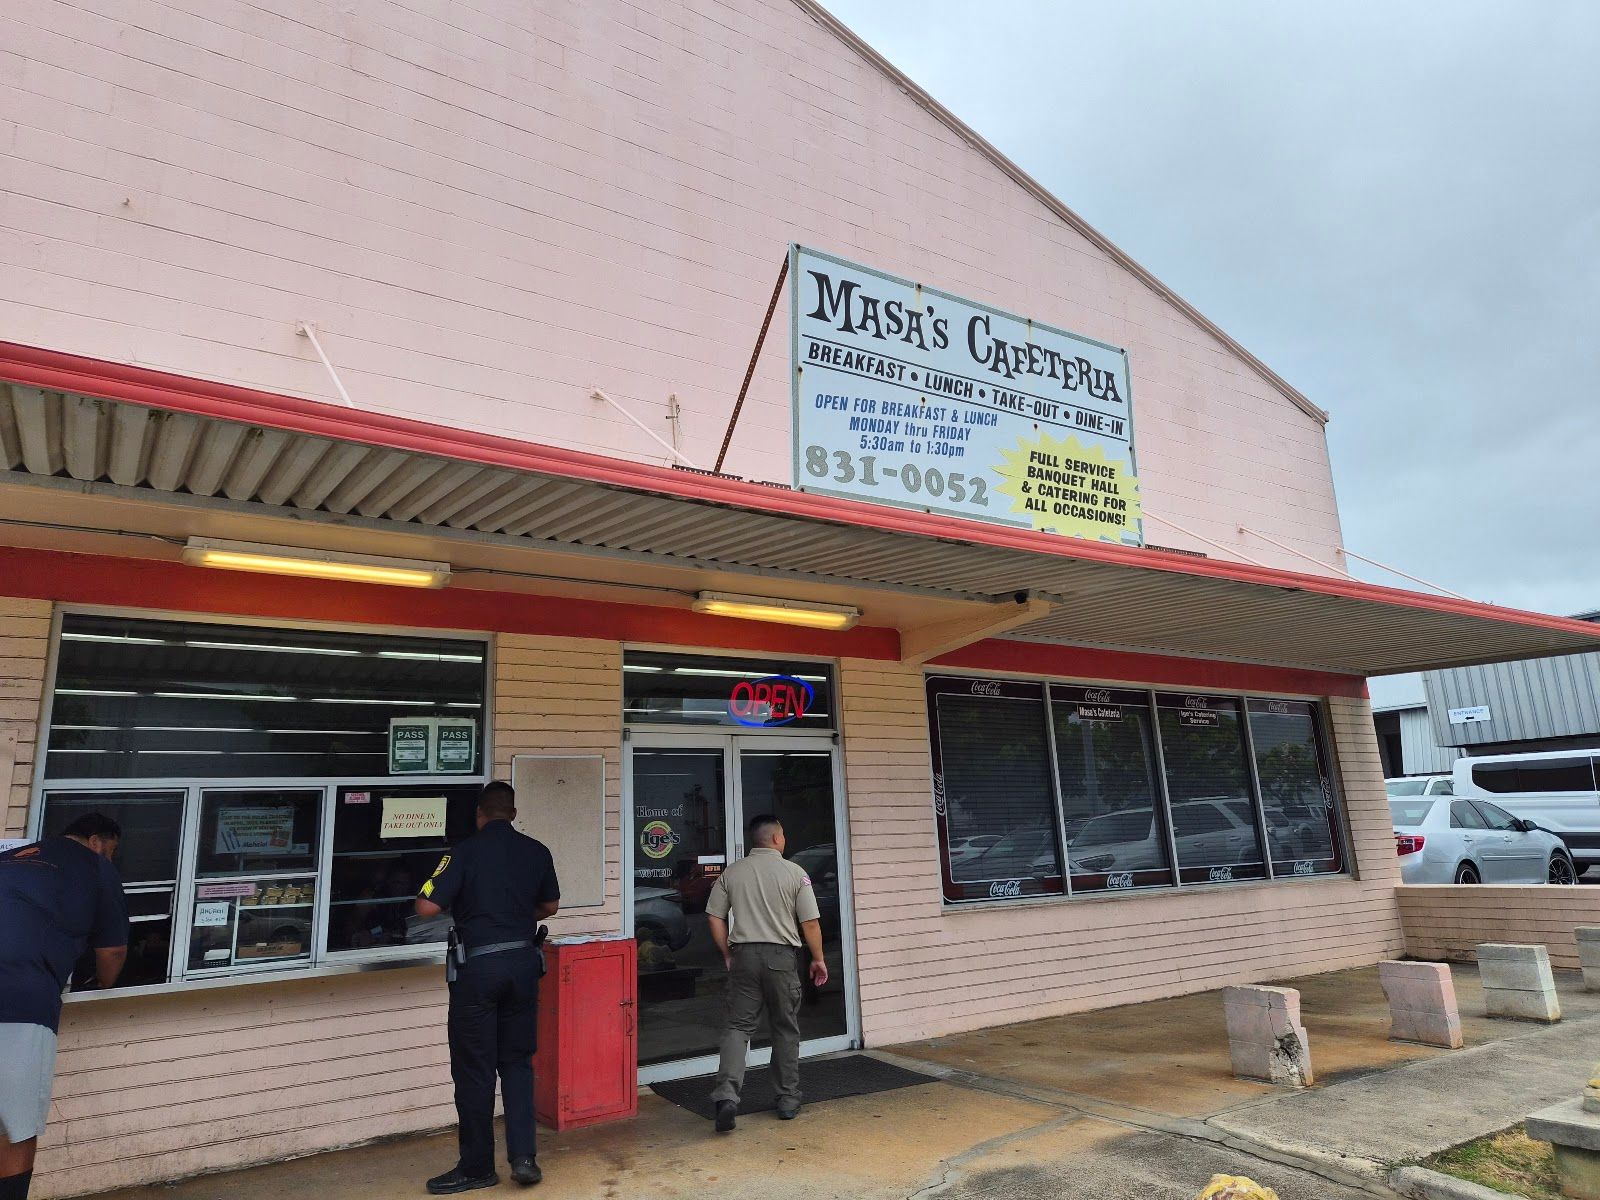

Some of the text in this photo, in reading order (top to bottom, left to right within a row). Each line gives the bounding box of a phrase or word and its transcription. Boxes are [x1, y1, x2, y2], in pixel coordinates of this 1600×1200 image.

[807, 270, 1123, 403] MASA'S CAFETERIA
[808, 342, 1124, 436] BREAKFAST LUNCH TAKE-OUT DINE-IN
[815, 393, 998, 426] OPEN FOR BREAKFAST & LUNCH
[849, 417, 970, 441] MONDAY thru FRIDAY
[860, 435, 965, 458] 5:30am to 1:30pm
[805, 445, 988, 507] 831-0052
[1030, 450, 1115, 479] FULL SERVICE
[1028, 466, 1119, 495] BANQUET HALL
[1021, 480, 1127, 511] & CATERING FOR
[1025, 497, 1126, 526] ALL OCCASIONS!
[731, 682, 805, 718] OPEN
[1079, 707, 1097, 717] Masa's
[636, 804, 683, 817] Home of
[641, 830, 680, 848] Ige's
